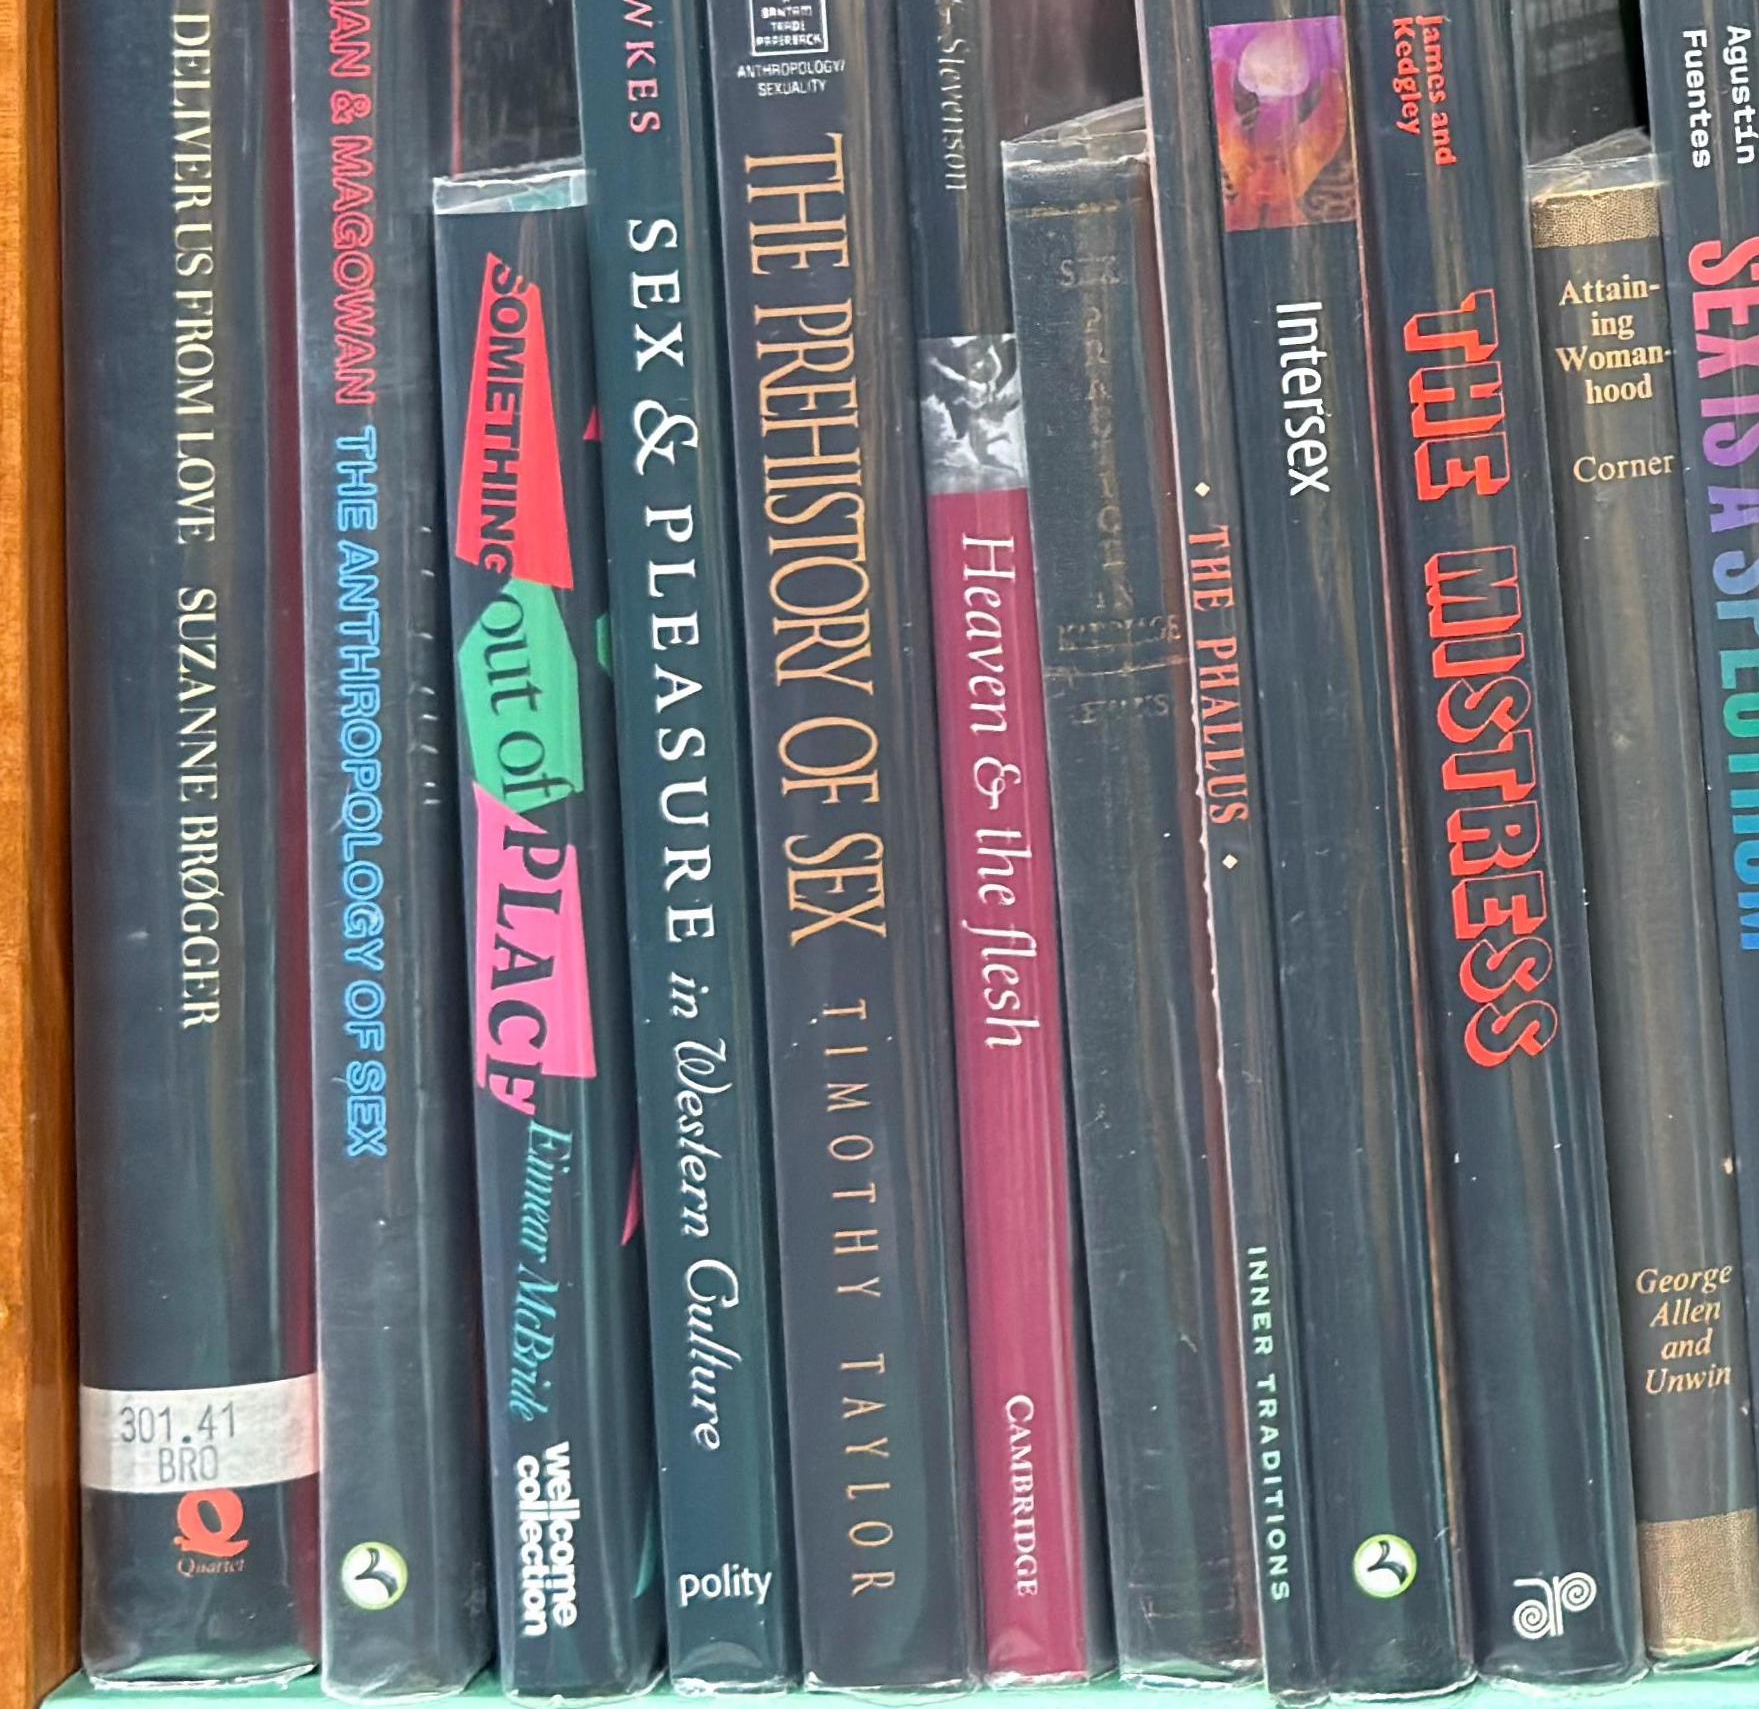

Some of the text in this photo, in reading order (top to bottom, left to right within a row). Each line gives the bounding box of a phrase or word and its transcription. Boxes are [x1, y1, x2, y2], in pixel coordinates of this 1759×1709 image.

[331, 91, 371, 125] &
[757, 79, 828, 96] SEXUALITY
[1392, 17, 1421, 136] Kedgley
[1417, 15, 1458, 168] James and
[1682, 28, 1711, 169] Fuentes
[331, 135, 377, 404] MAGOWAN
[1559, 276, 1661, 306] Attain-
[1554, 344, 1669, 373] Woman-
[1591, 313, 1635, 340] ing
[1276, 301, 1330, 496] Intersex
[1585, 374, 1652, 404] hood
[171, 13, 221, 1029] DELIVER FROM LOVE SUZANNE BRØGGER
[336, 424, 378, 530] THE
[1573, 453, 1675, 484] Corner
[962, 533, 1032, 906] Heaven the
[1189, 525, 1249, 824] THE PHALLUS
[1404, 289, 1558, 1068] THE MISTRESS
[336, 541, 383, 970] ANTHROPOLOGY
[628, 219, 731, 1239] SEX & PLEASURE Western
[745, 132, 896, 1598] THE PREHISTORY OF SEX TIMOTHY TAYLOR
[343, 979, 385, 1052] OF
[346, 1078, 387, 1158] SEX
[1636, 1262, 1733, 1296] George
[1650, 1297, 1721, 1327] Allen
[1644, 1363, 1731, 1395] Unwin
[1661, 1331, 1711, 1360] and
[121, 1403, 236, 1444] 301.41
[158, 1446, 219, 1483] BRO
[1246, 1246, 1290, 1601] INNER TRADITIONS
[517, 1455, 549, 1636] collection
[541, 1441, 578, 1628] wellcome
[1005, 1394, 1038, 1597] CAMBRIDGE
[679, 1564, 772, 1607] polity
